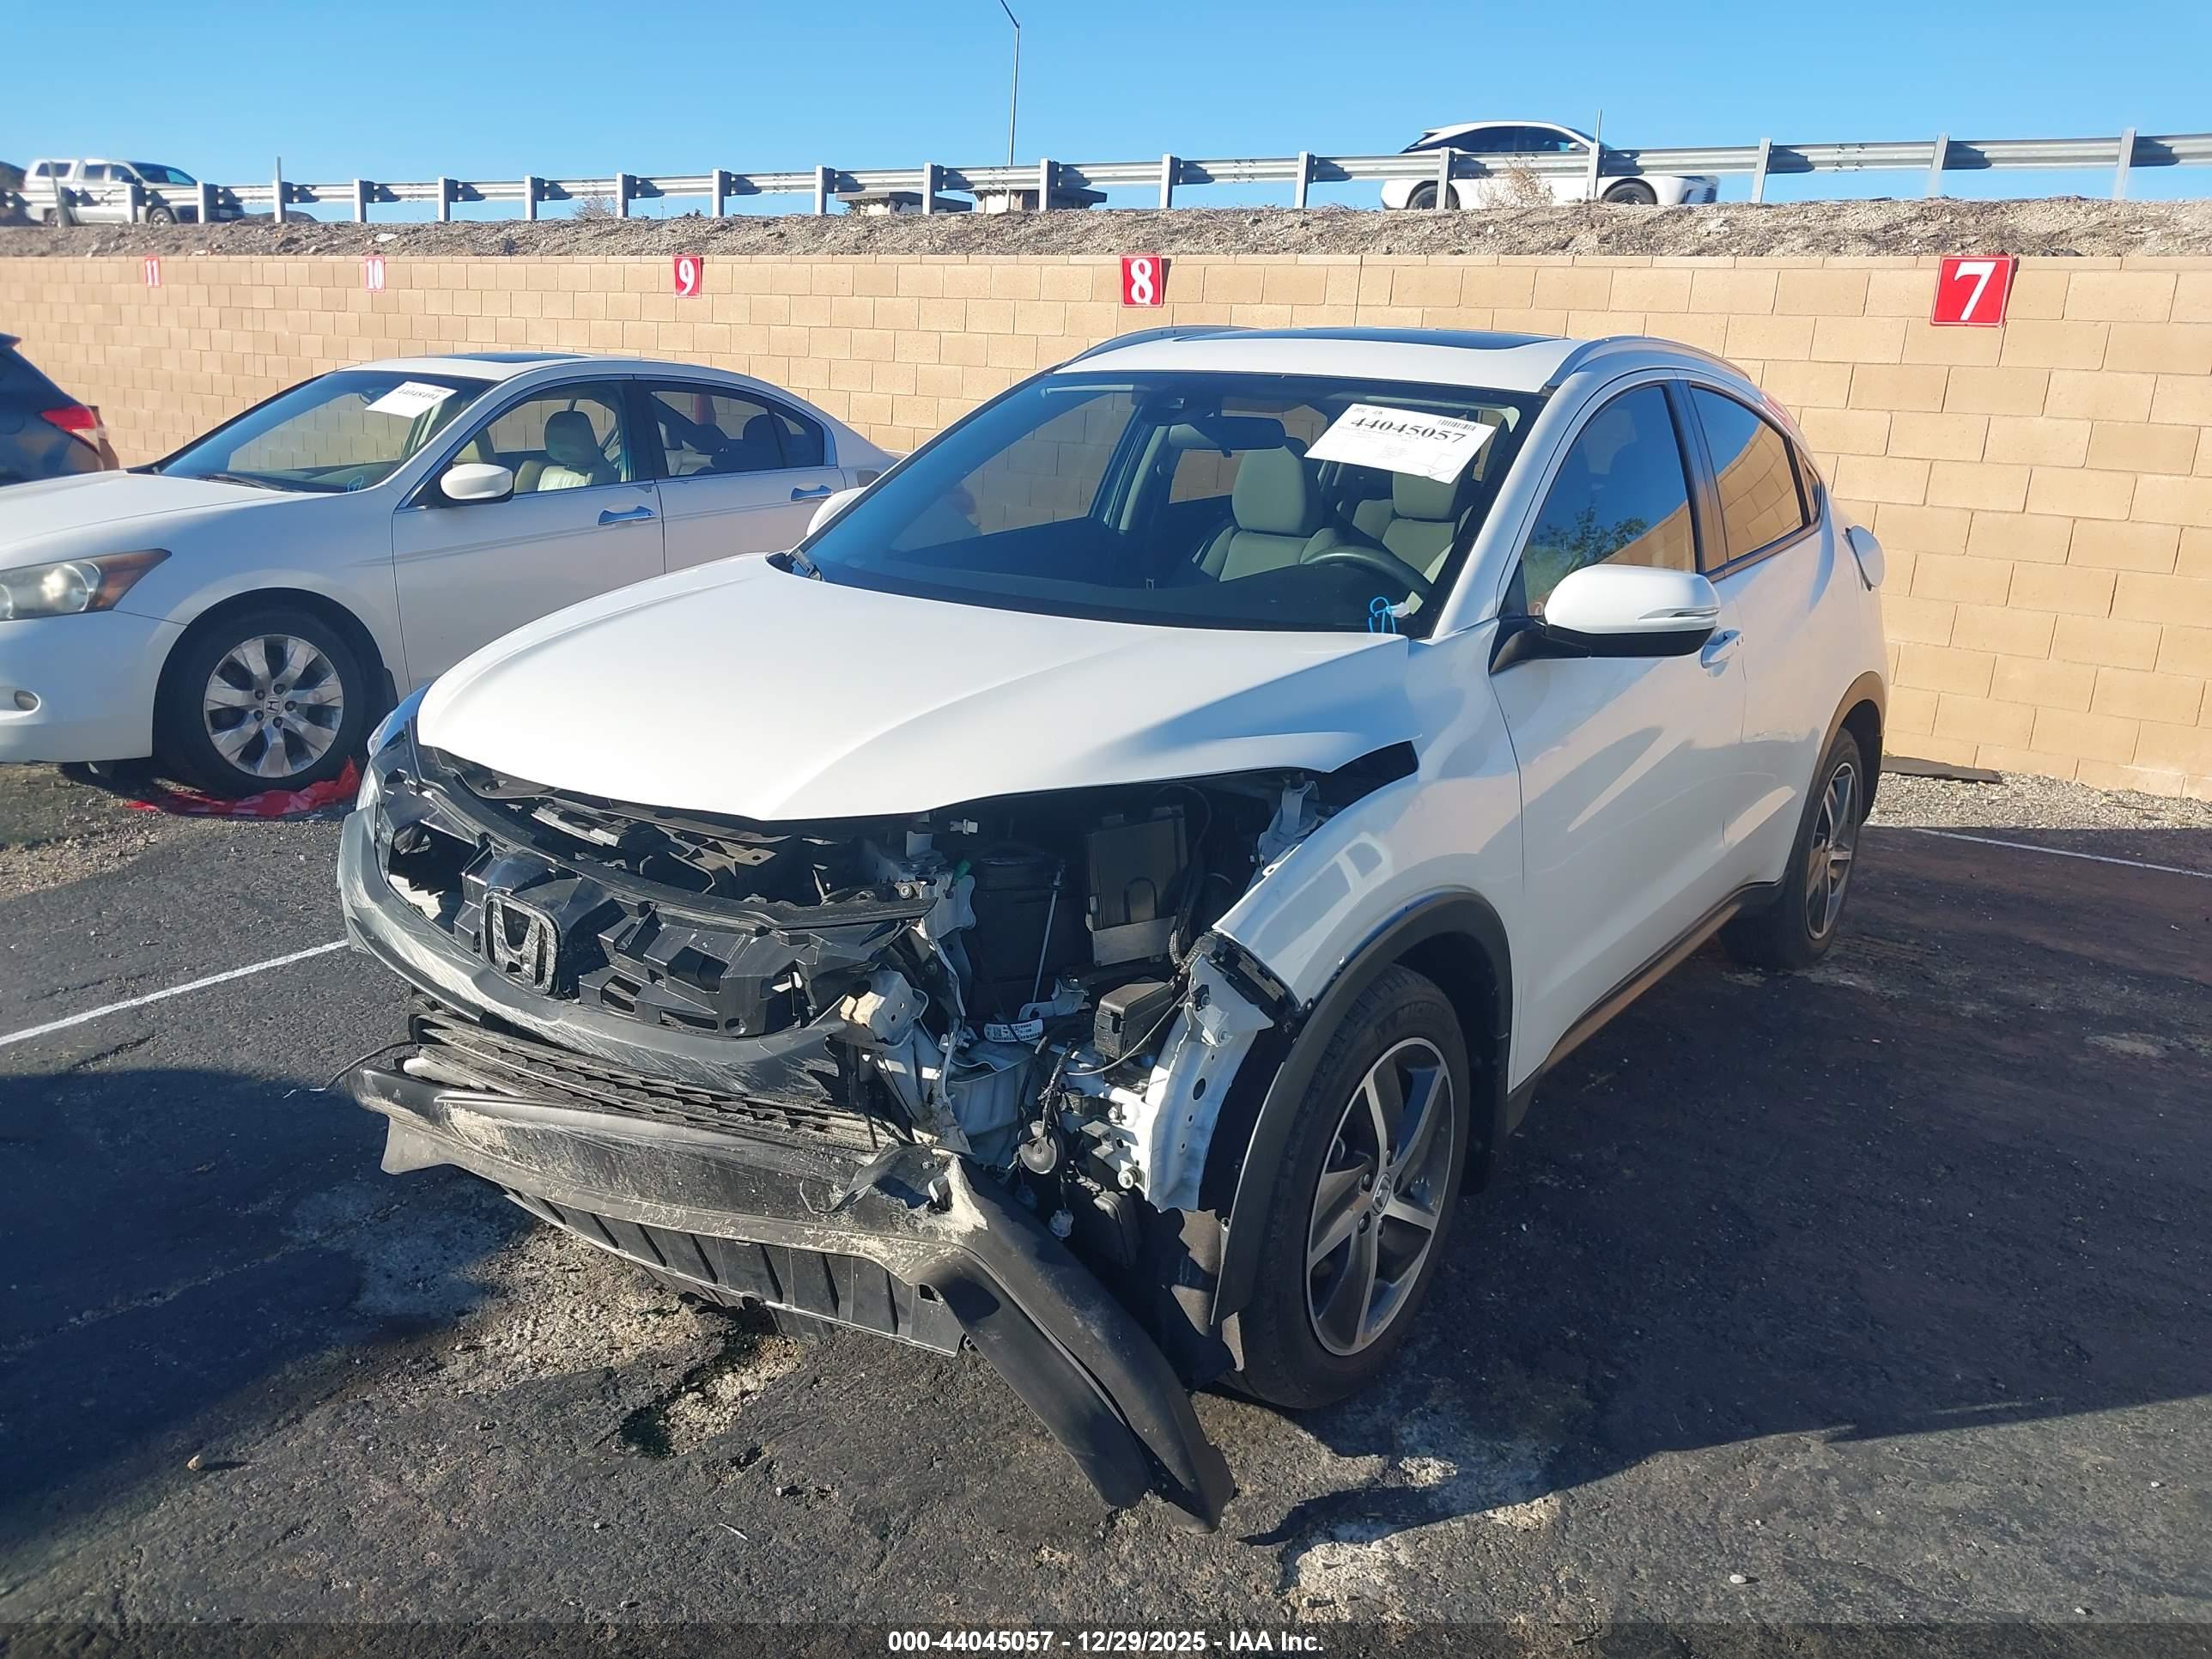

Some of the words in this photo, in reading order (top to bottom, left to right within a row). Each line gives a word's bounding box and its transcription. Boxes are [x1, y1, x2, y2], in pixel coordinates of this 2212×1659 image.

[145, 259, 160, 286] 11
[367, 259, 383, 289] 10
[678, 258, 695, 295] 9
[1130, 258, 1154, 305] 8
[1954, 260, 1996, 321] 7
[1351, 417, 1468, 444] 44045057
